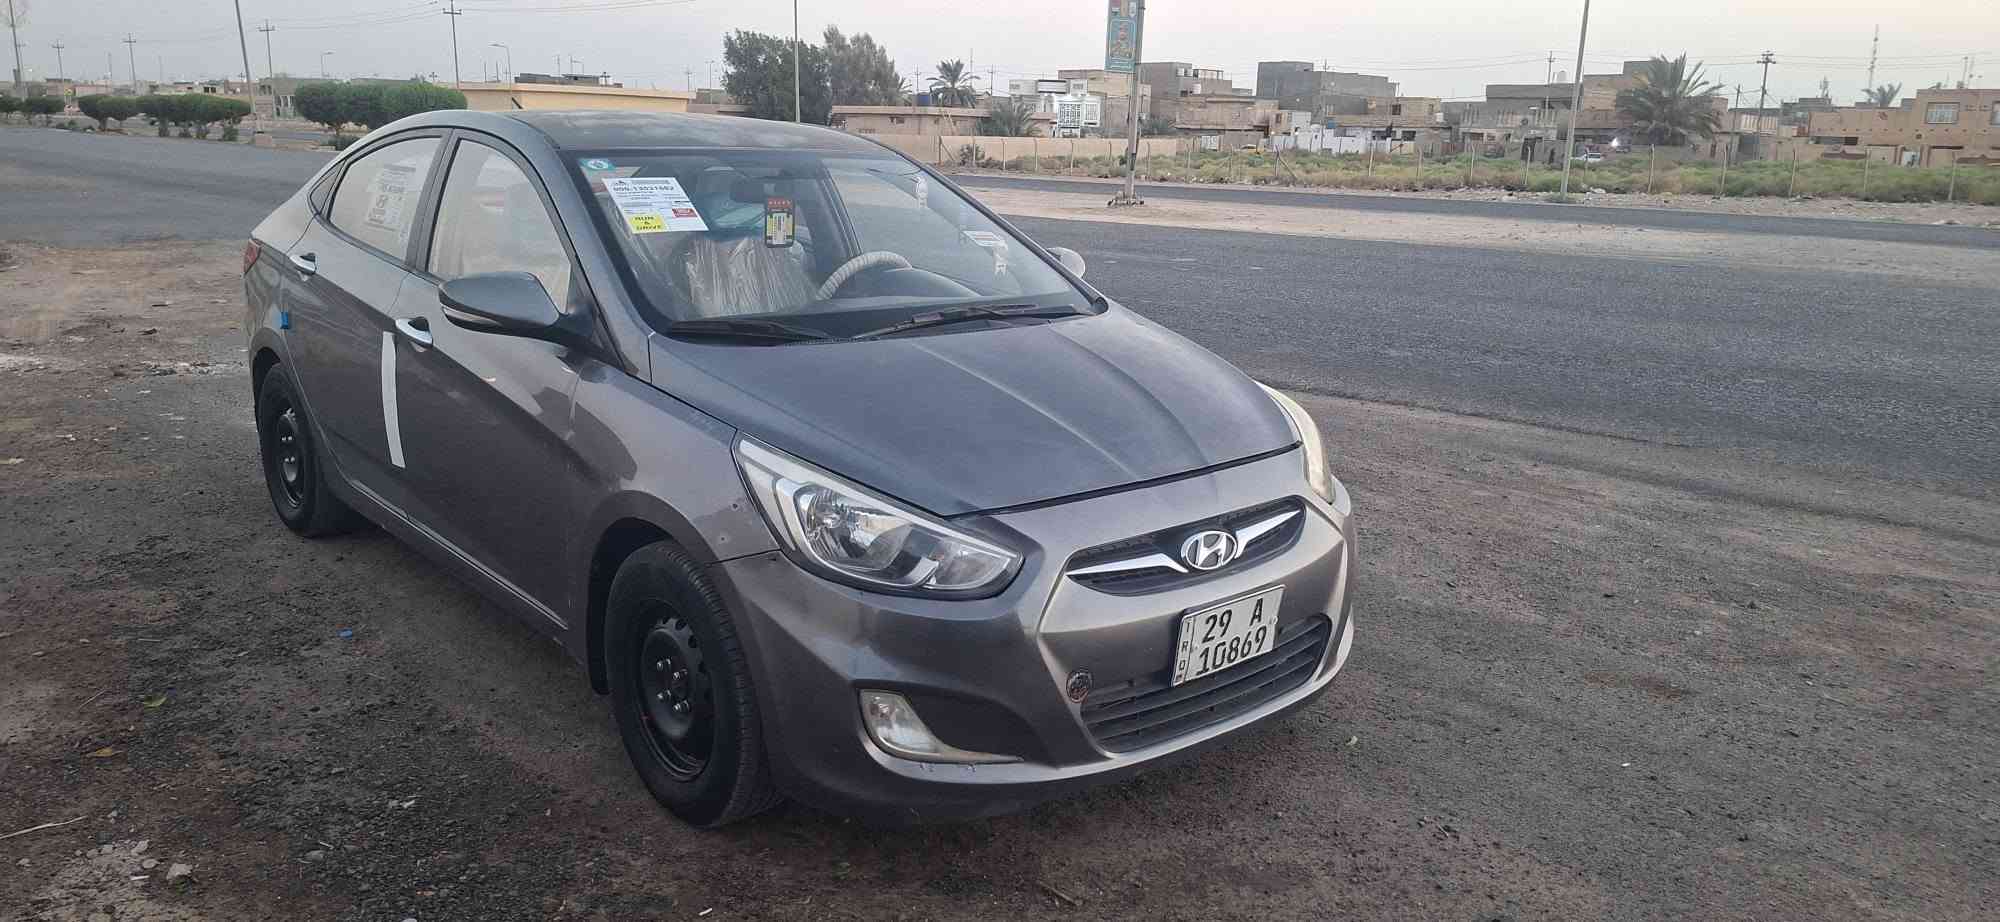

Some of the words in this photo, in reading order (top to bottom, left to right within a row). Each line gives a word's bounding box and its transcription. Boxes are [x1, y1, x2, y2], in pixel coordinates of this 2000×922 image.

[1202, 609, 1232, 643] 29
[1249, 597, 1264, 626] A
[1196, 625, 1267, 676] 10869
